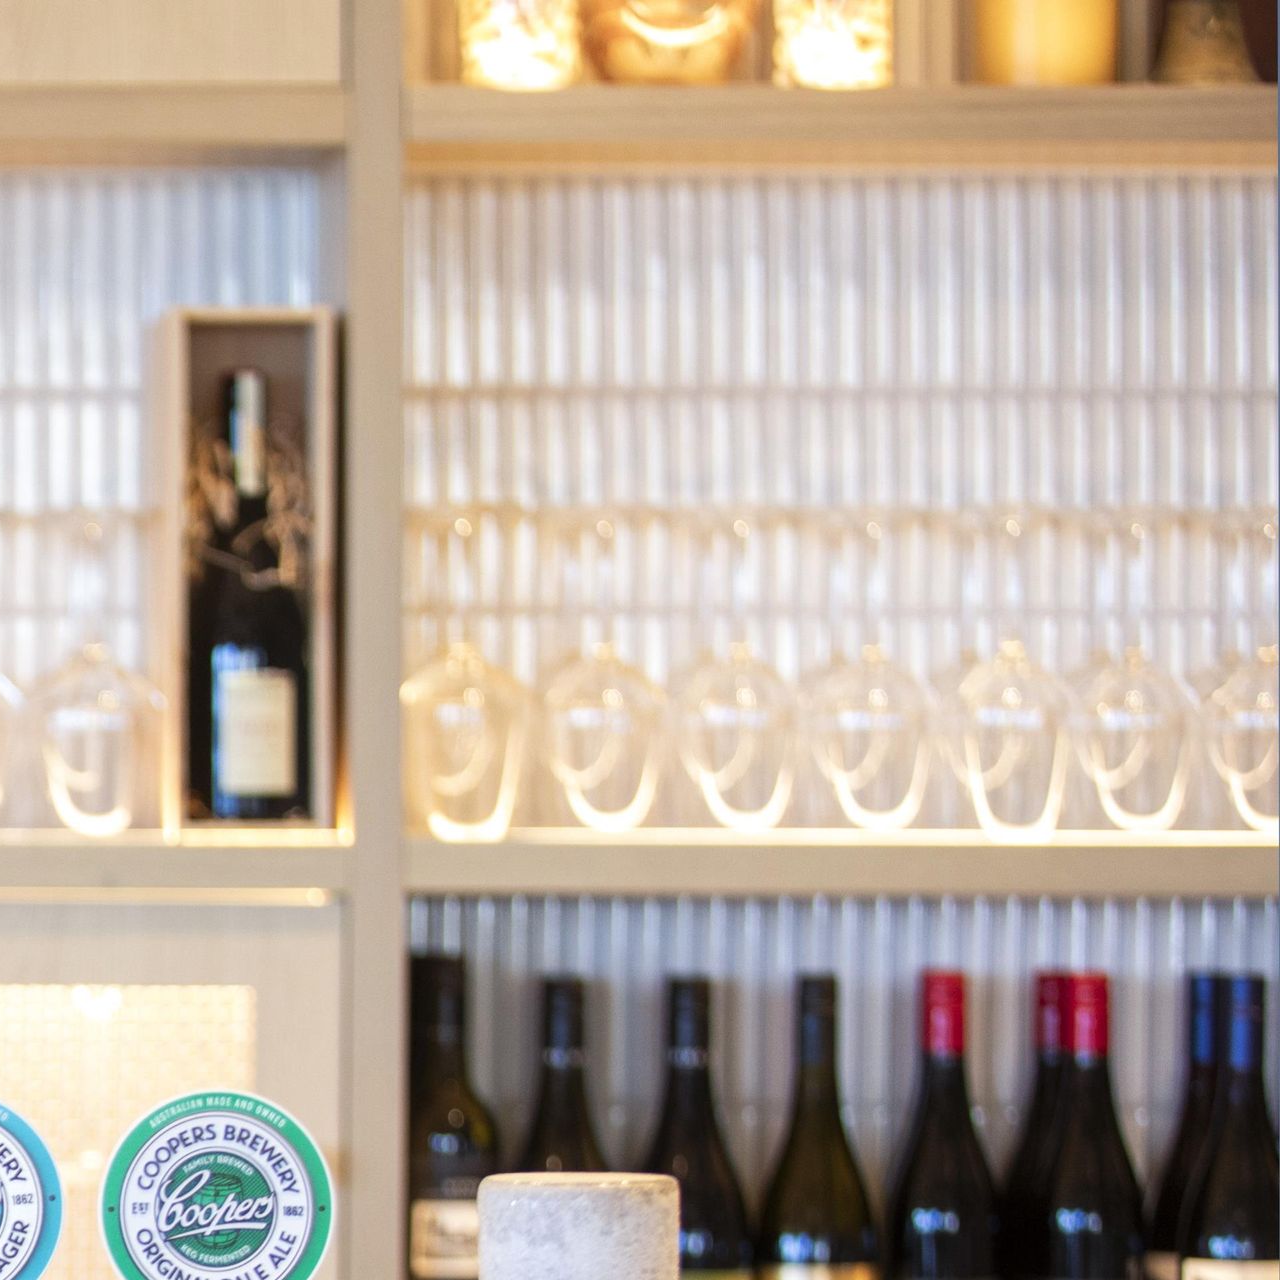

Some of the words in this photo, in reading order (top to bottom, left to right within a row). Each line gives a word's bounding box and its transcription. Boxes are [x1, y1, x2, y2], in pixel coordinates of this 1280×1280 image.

[150, 1099, 203, 1128] AUSTRALIAN
[206, 1097, 232, 1107] MADE
[235, 1099, 252, 1111] AND
[255, 1106, 286, 1128] OWNED
[138, 1125, 216, 1190] COOPERS
[223, 1125, 300, 1195] BREWERY
[183, 1156, 215, 1173] FAMILY
[217, 1156, 254, 1176] BREWED
[12, 1194, 33, 1205] 1862
[157, 1169, 277, 1236] Coopers
[181, 1245, 196, 1260] KEG
[268, 1231, 296, 1269] ALE
